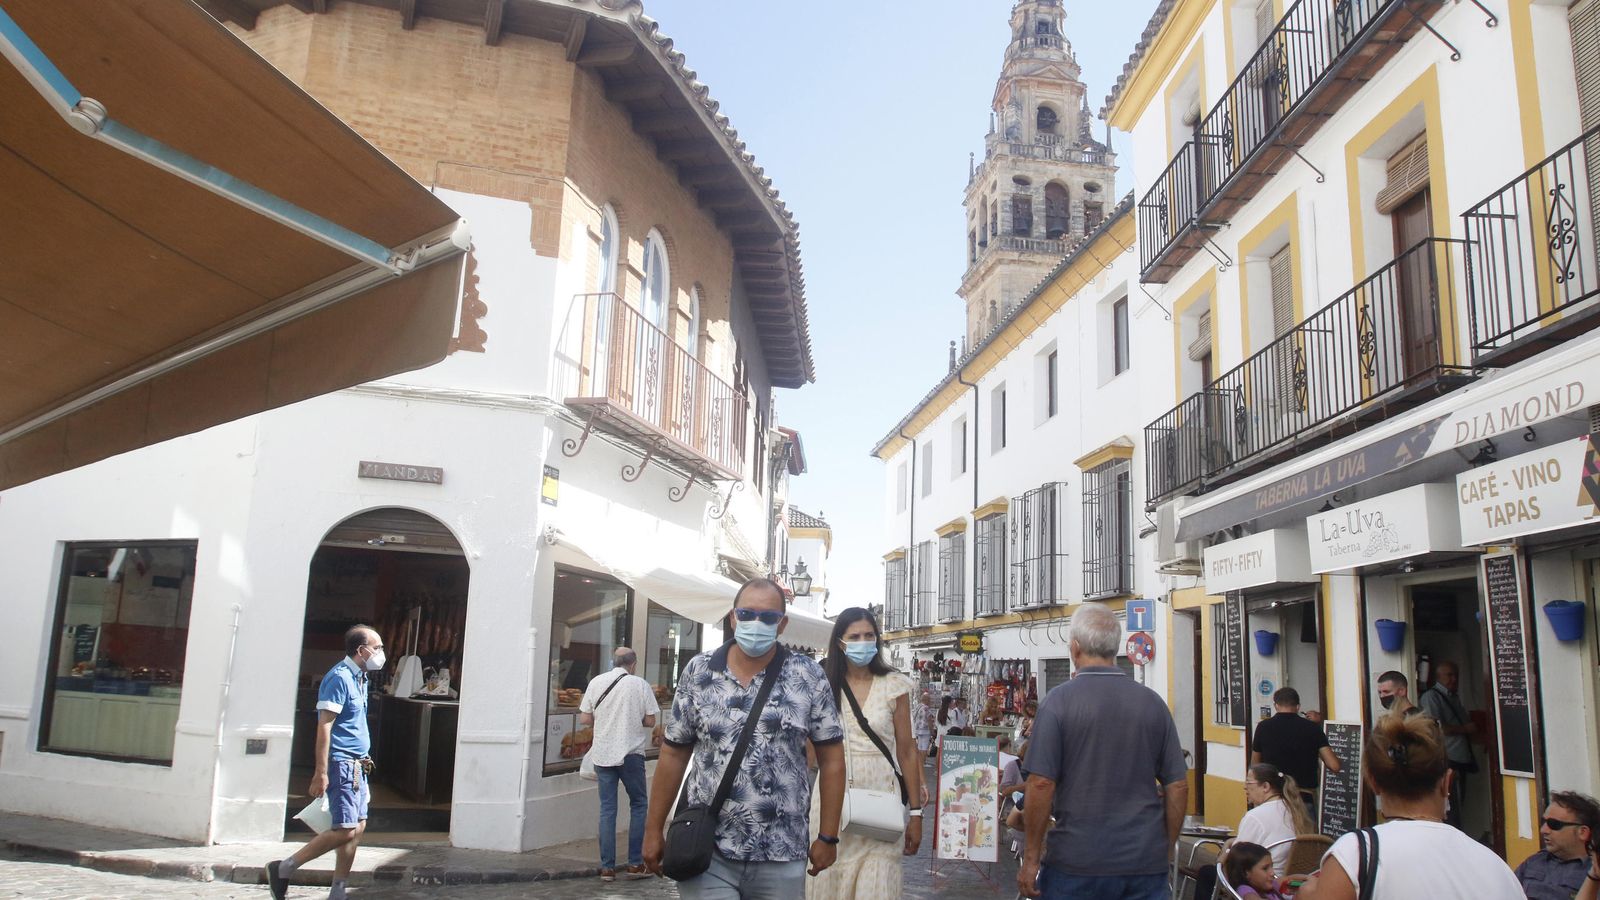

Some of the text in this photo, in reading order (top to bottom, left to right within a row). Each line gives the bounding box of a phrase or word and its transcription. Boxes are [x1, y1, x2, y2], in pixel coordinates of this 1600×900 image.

[1454, 381, 1585, 445] DIAMOND
[1255, 453, 1366, 511] TABERNA LA UVA
[1460, 470, 1499, 505] CAFÉ
[1512, 458, 1561, 491] VINO
[1483, 496, 1541, 528] TAPAS
[1327, 542, 1361, 557] Taberna
